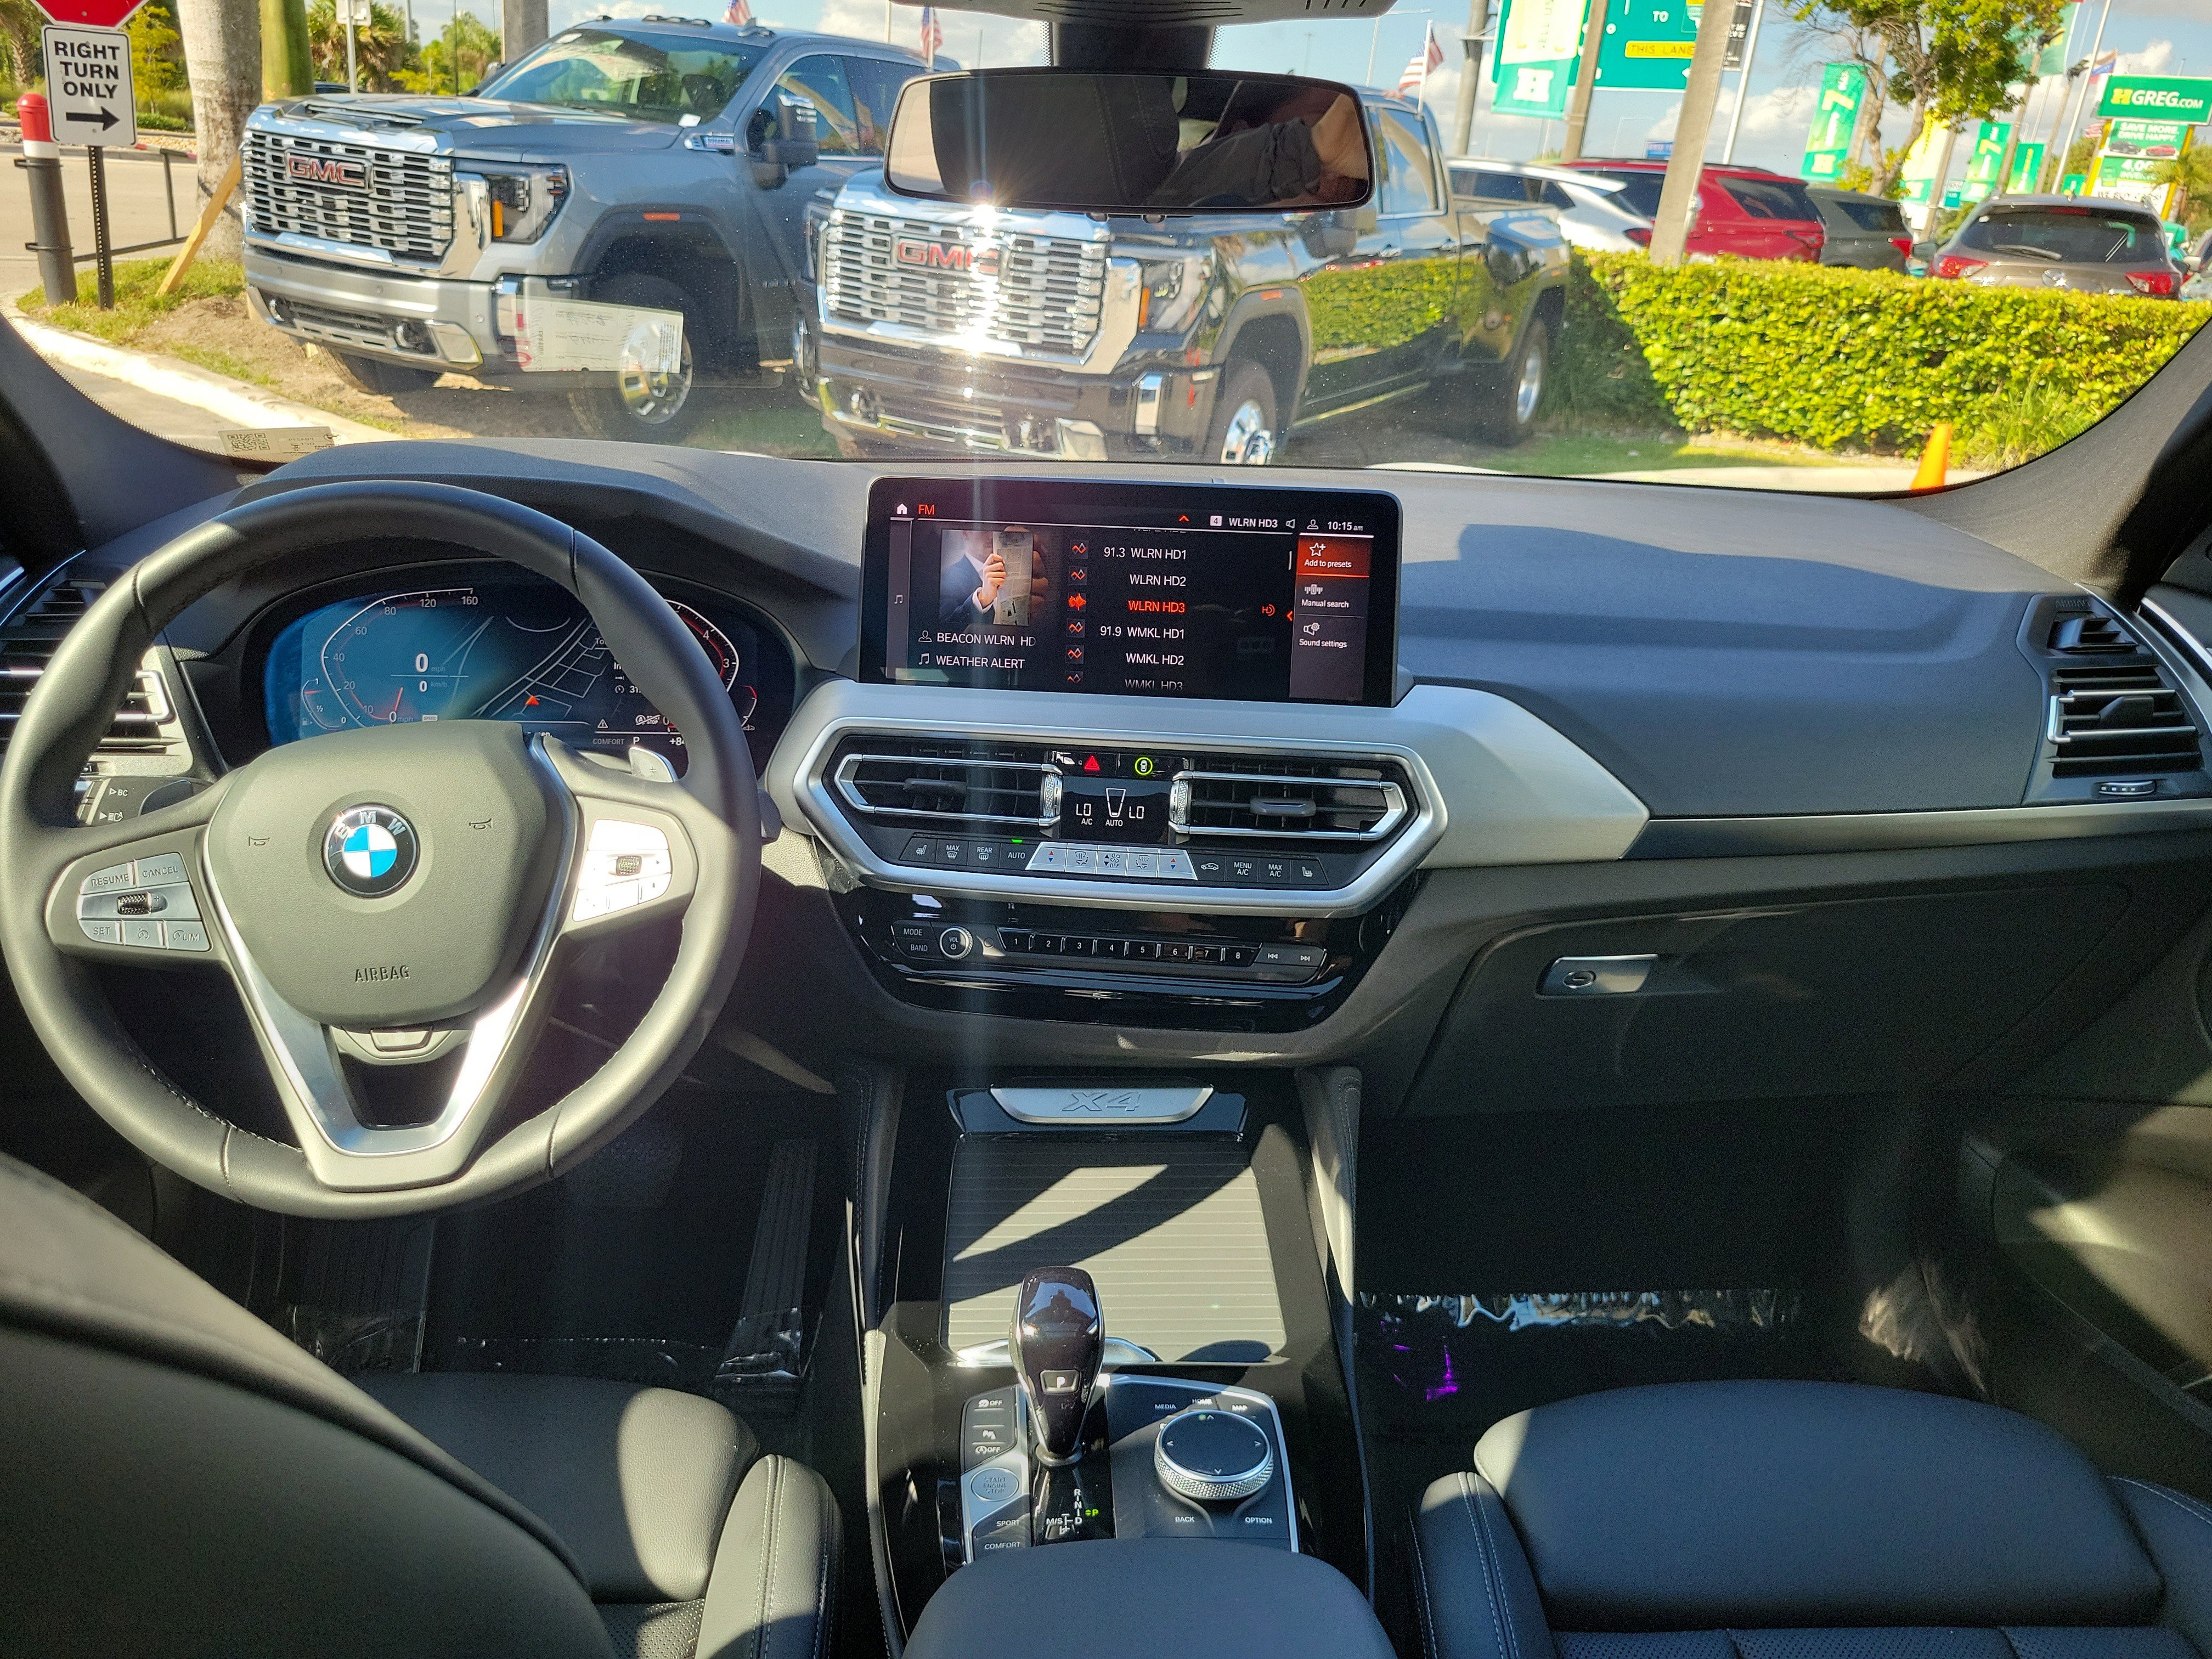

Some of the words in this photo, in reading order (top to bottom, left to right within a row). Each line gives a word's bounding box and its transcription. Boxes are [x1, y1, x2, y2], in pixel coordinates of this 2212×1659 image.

[1653, 10, 1668, 22] TO
[55, 41, 120, 59] RIGHT
[1631, 44, 1655, 55] THIS
[1662, 45, 1695, 55] LANE
[60, 61, 119, 80] TURN
[63, 80, 117, 99] ONLY
[2120, 122, 2146, 132] SAVE
[287, 156, 365, 185] GMC
[898, 241, 998, 274] GMC
[918, 505, 935, 515] FM
[1229, 517, 1257, 527] WLRN
[1259, 519, 1278, 528] HD3
[1327, 521, 1352, 531] 10:15
[1104, 547, 1125, 557] 91.3
[1131, 548, 1163, 558] WLRN
[1165, 550, 1187, 560] HD1
[1328, 561, 1352, 569] presets
[1130, 574, 1161, 585] WLRN
[1164, 575, 1186, 586] HD2
[420, 599, 437, 608] 120
[461, 596, 478, 605] 160
[1301, 599, 1325, 607] Manual
[1327, 600, 1349, 608] search
[385, 607, 396, 616] 80
[1128, 601, 1160, 612] WLRN
[1163, 602, 1186, 613] HD3
[356, 627, 367, 636] 60
[703, 630, 709, 640] 4
[1100, 626, 1121, 636] 91.9
[1127, 627, 1160, 638] WMKL
[1163, 628, 1184, 639] HD1
[937, 633, 981, 645] BEACON
[984, 634, 1014, 645] WLRN
[1020, 636, 1036, 647] HD
[1322, 640, 1347, 648] settings
[333, 653, 345, 662] 40
[415, 653, 428, 673] 0
[936, 656, 988, 667] WEATHER
[991, 657, 1025, 669] ALERT
[1126, 653, 1159, 664] WMKL
[1162, 655, 1184, 665] HD2
[723, 659, 730, 668] 3
[344, 681, 355, 690] 20
[419, 681, 428, 692] 0
[363, 705, 374, 713] 10
[389, 712, 397, 723] 0
[633, 737, 640, 745] P
[1076, 803, 1091, 816] LO
[1128, 806, 1144, 820] LO
[335, 810, 406, 840] BMW
[1105, 819, 1123, 827] AUTO
[1234, 861, 1252, 870] MENU
[142, 865, 179, 878] CANCEL
[91, 873, 129, 887] RESUME
[93, 926, 111, 936] SET
[904, 928, 923, 936] MODE
[183, 933, 200, 943] LIM
[911, 944, 928, 952] BAND
[354, 966, 410, 983] AIRBAG
[1062, 1091, 1142, 1112] X4
[1057, 1376, 1065, 1389] P
[1074, 1488, 1081, 1497] R
[985, 1542, 1020, 1550] COMFORT
